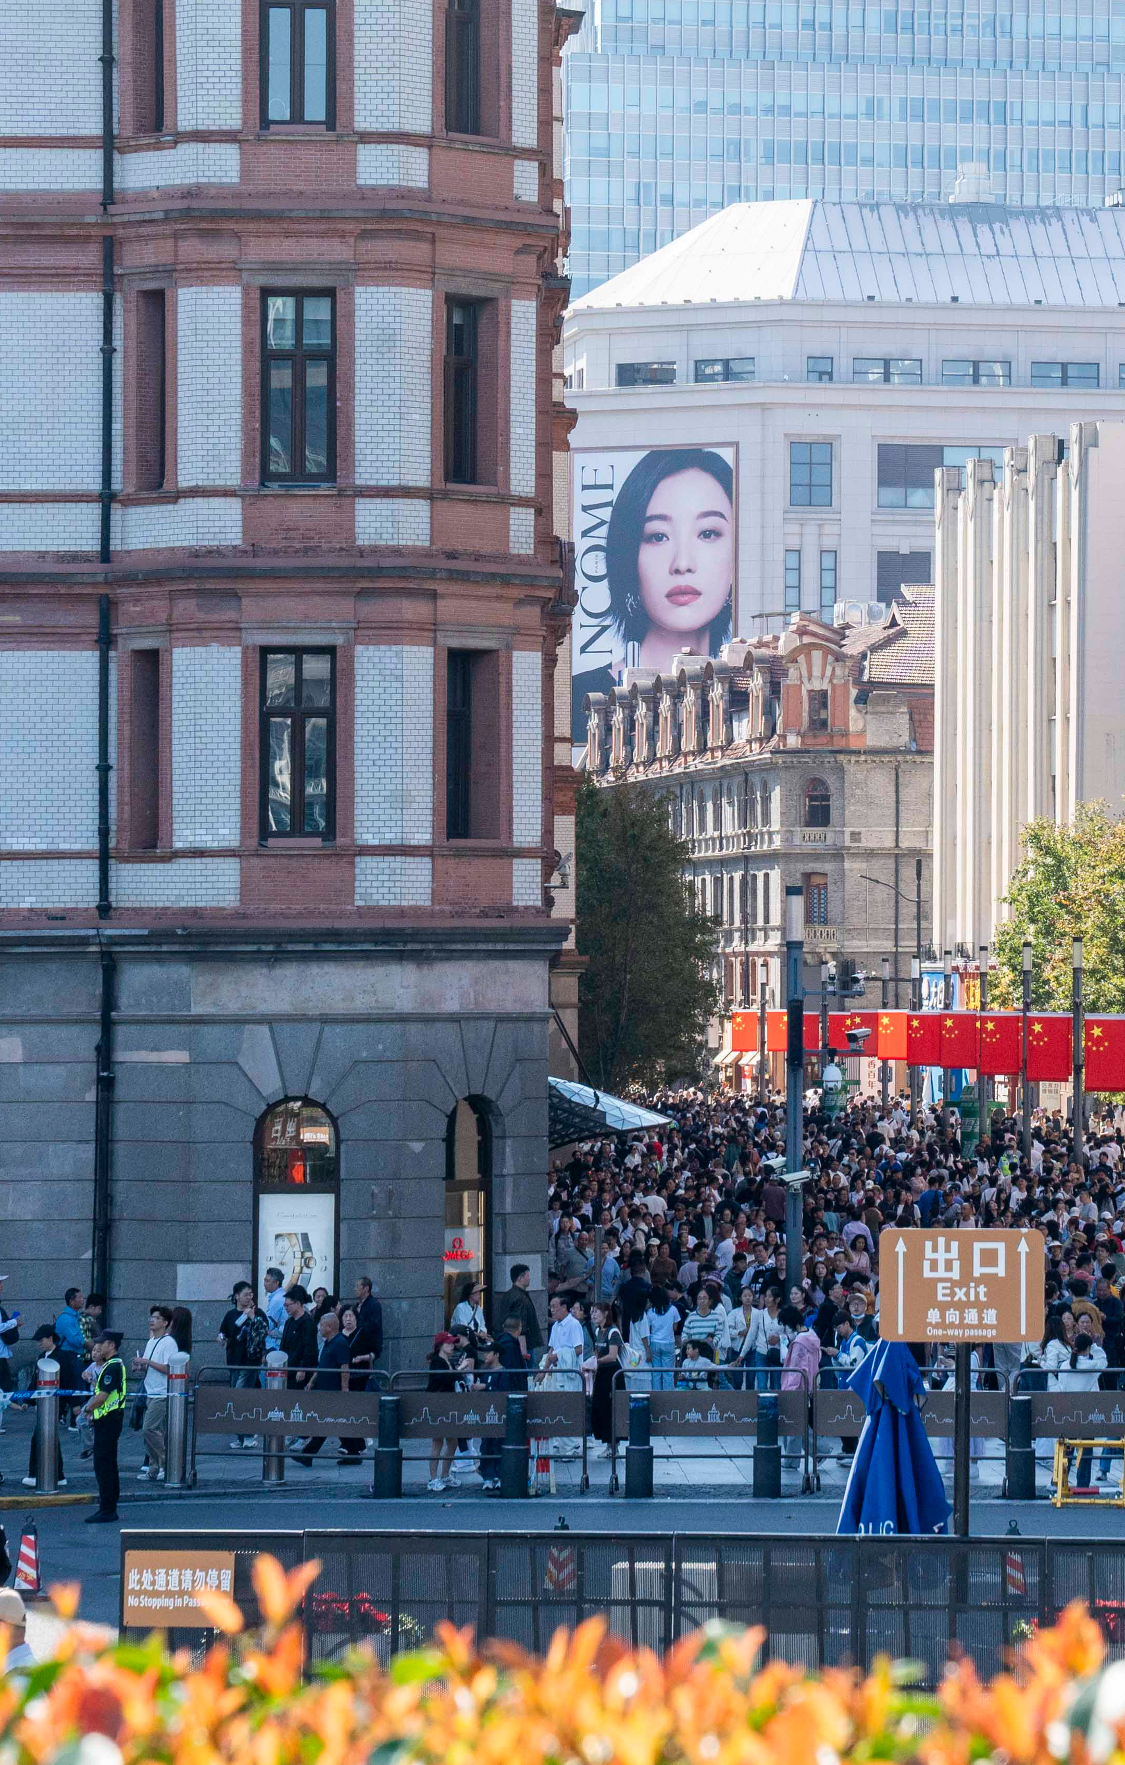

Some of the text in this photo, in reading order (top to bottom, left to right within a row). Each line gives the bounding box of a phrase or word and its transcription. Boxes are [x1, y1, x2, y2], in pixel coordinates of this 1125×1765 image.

[922, 1236, 1006, 1280] 出口
[936, 1282, 988, 1301] Exit
[926, 1308, 998, 1325] 单向通道
[926, 1326, 997, 1338] One-way passage
[127, 1568, 232, 1592] 此处通道请勿停留
[127, 1594, 139, 1607] No
[139, 1594, 174, 1610] Stopping
[174, 1594, 183, 1607] in
